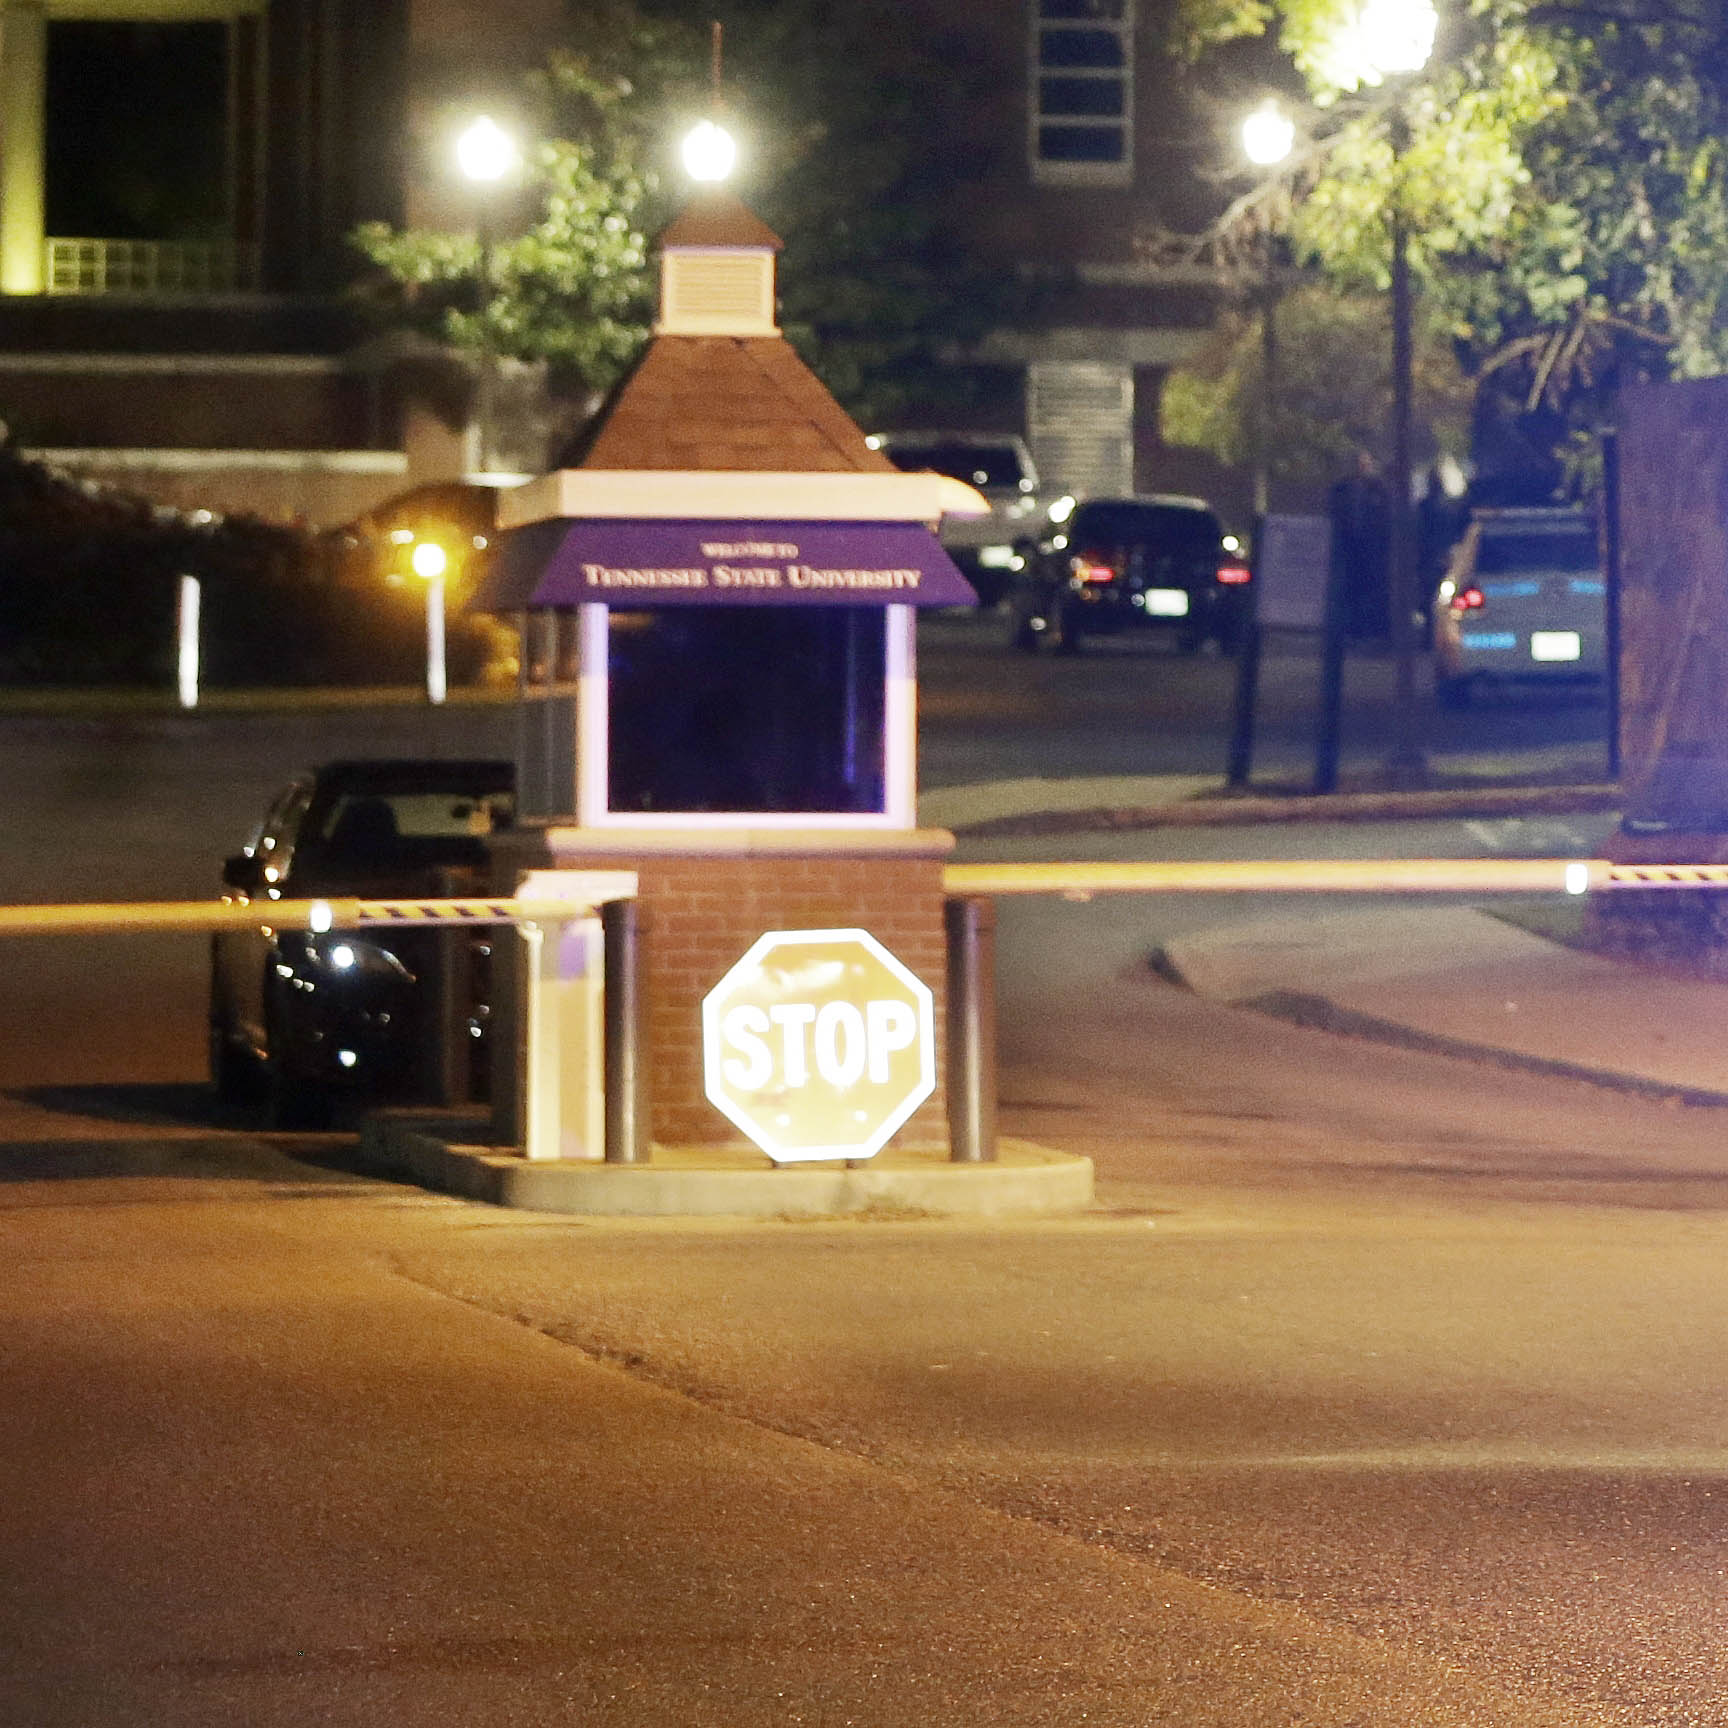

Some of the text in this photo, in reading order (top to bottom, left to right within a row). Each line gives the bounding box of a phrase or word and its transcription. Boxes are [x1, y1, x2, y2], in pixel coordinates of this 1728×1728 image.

[701, 542, 798, 559] WELCOME TO
[583, 563, 921, 588] TENNESSEE STATE UNIVERSITY
[721, 999, 918, 1092] STOP
